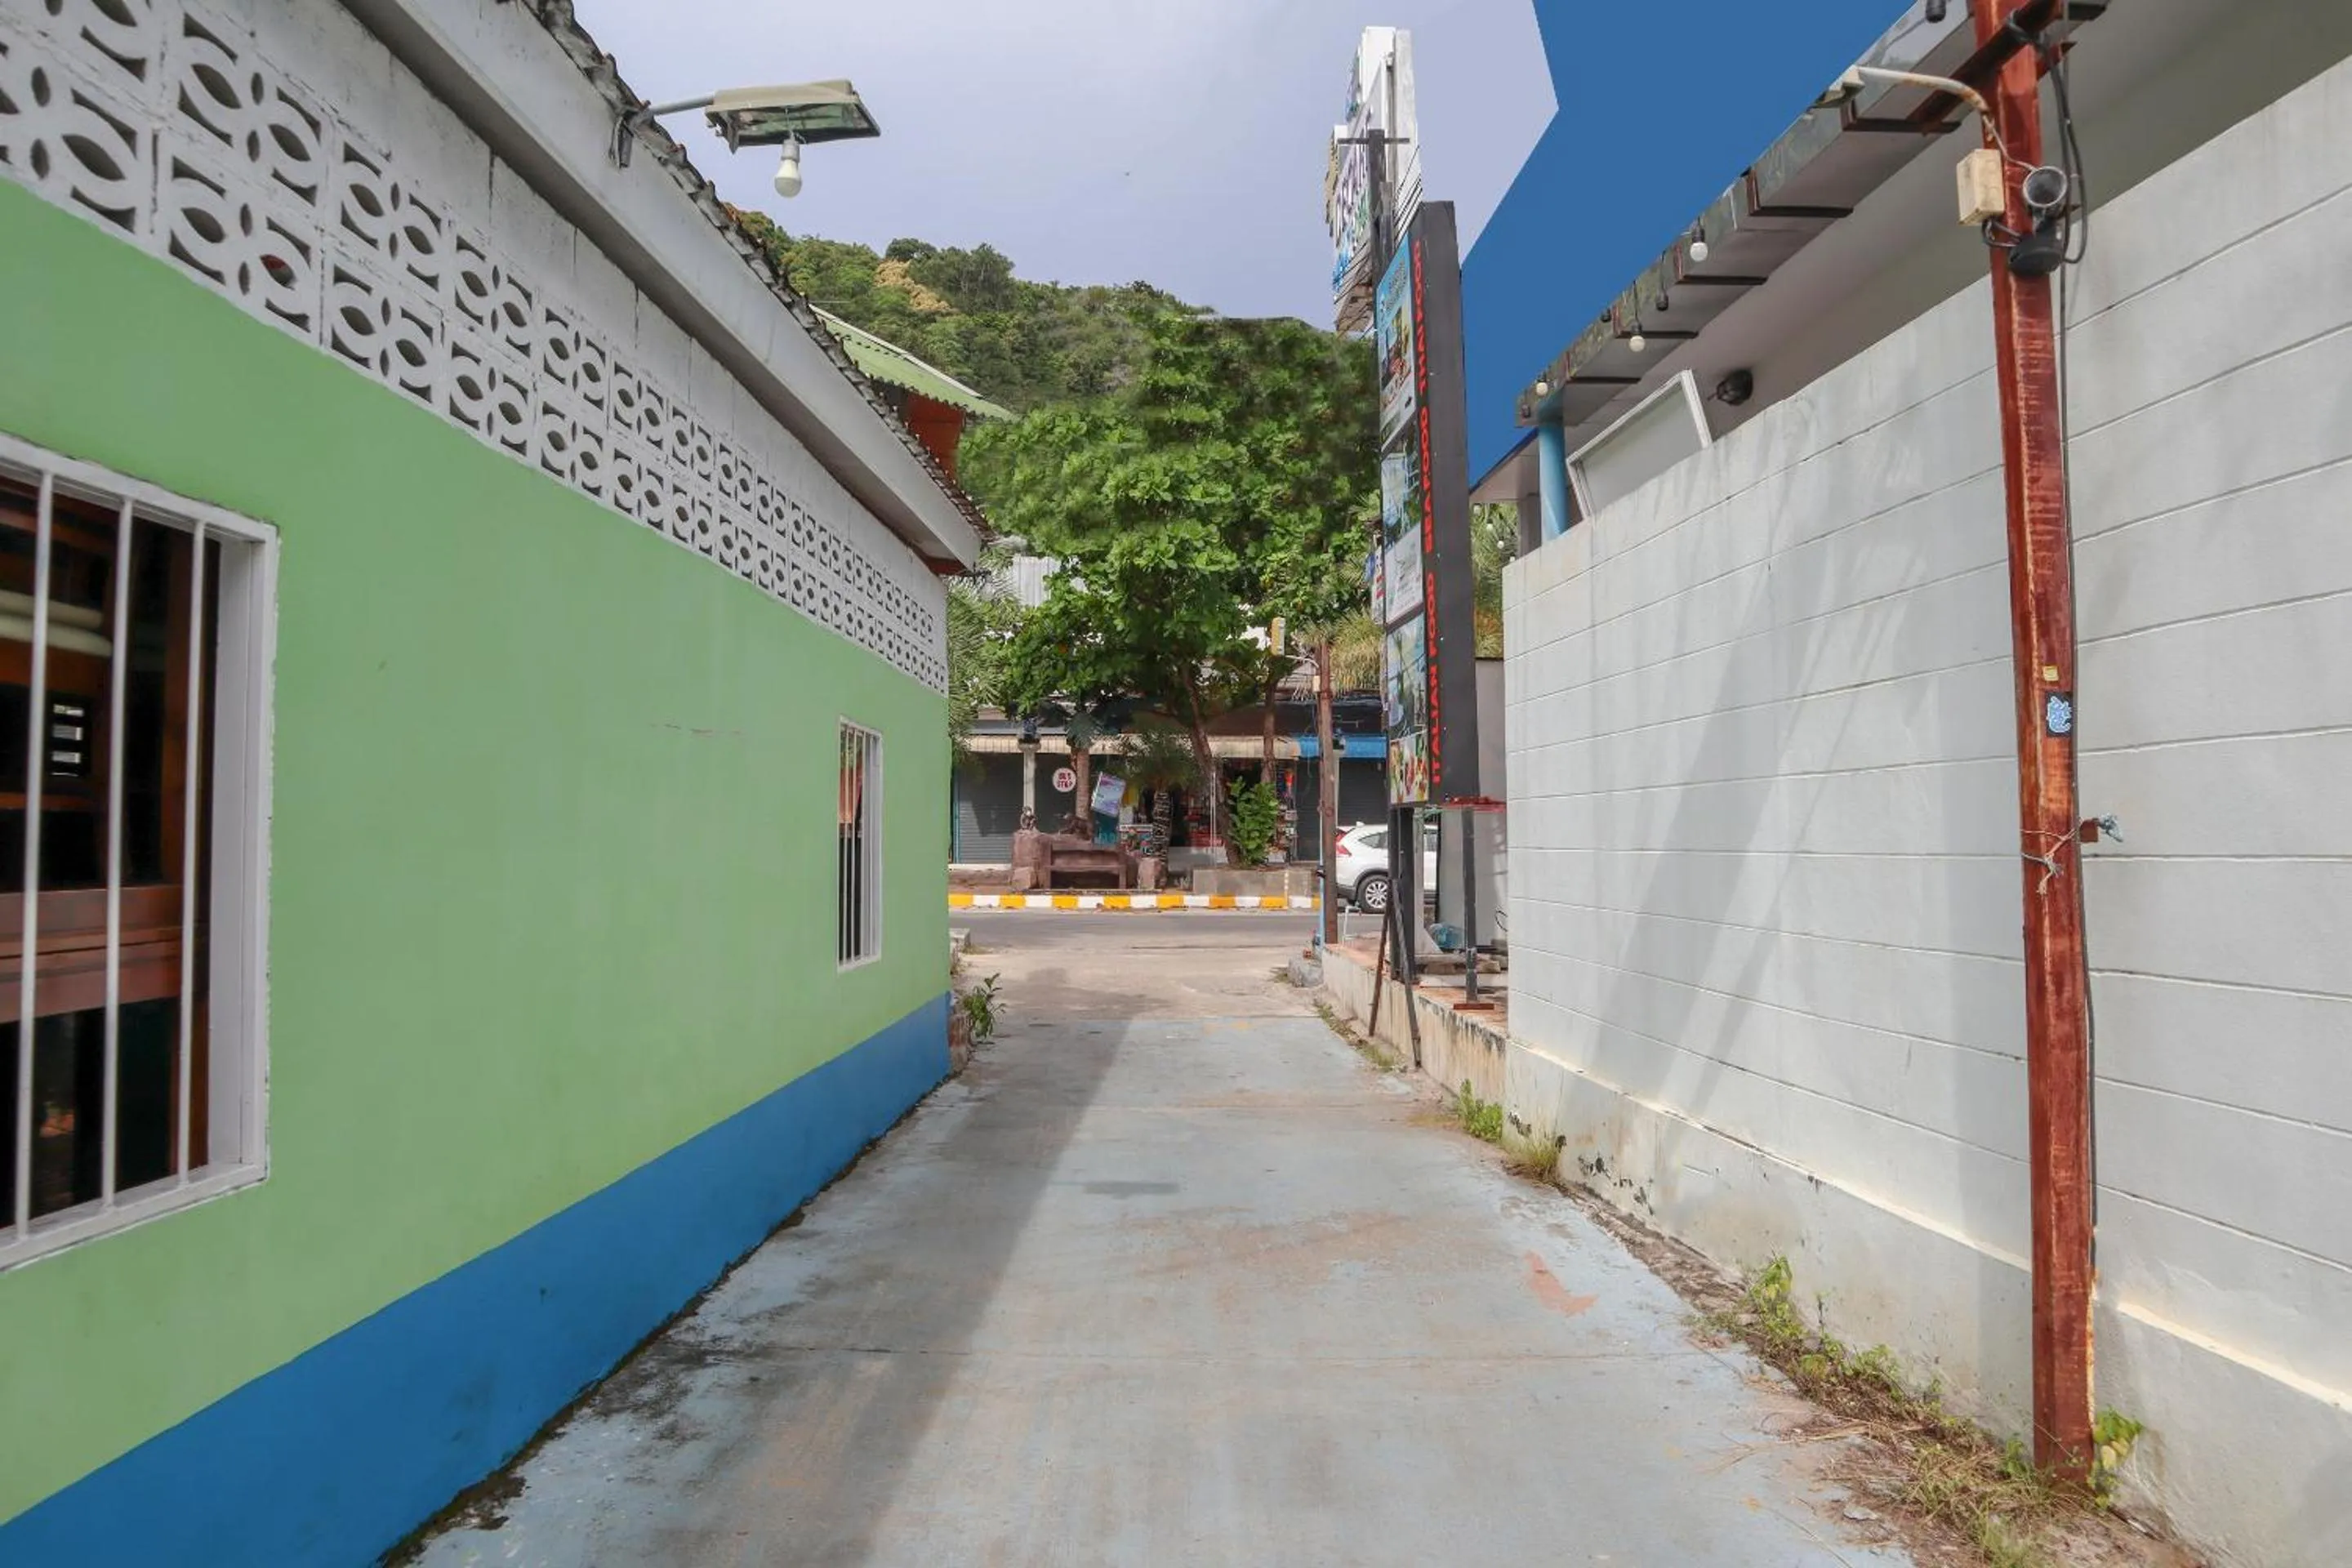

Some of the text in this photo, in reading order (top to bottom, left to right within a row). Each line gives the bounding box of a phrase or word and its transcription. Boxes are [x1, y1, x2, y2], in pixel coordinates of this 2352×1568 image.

[1420, 406, 1434, 554] SEAFOOD
[1427, 572, 1437, 657] FOOD
[1428, 664, 1441, 785] ITALIAN
